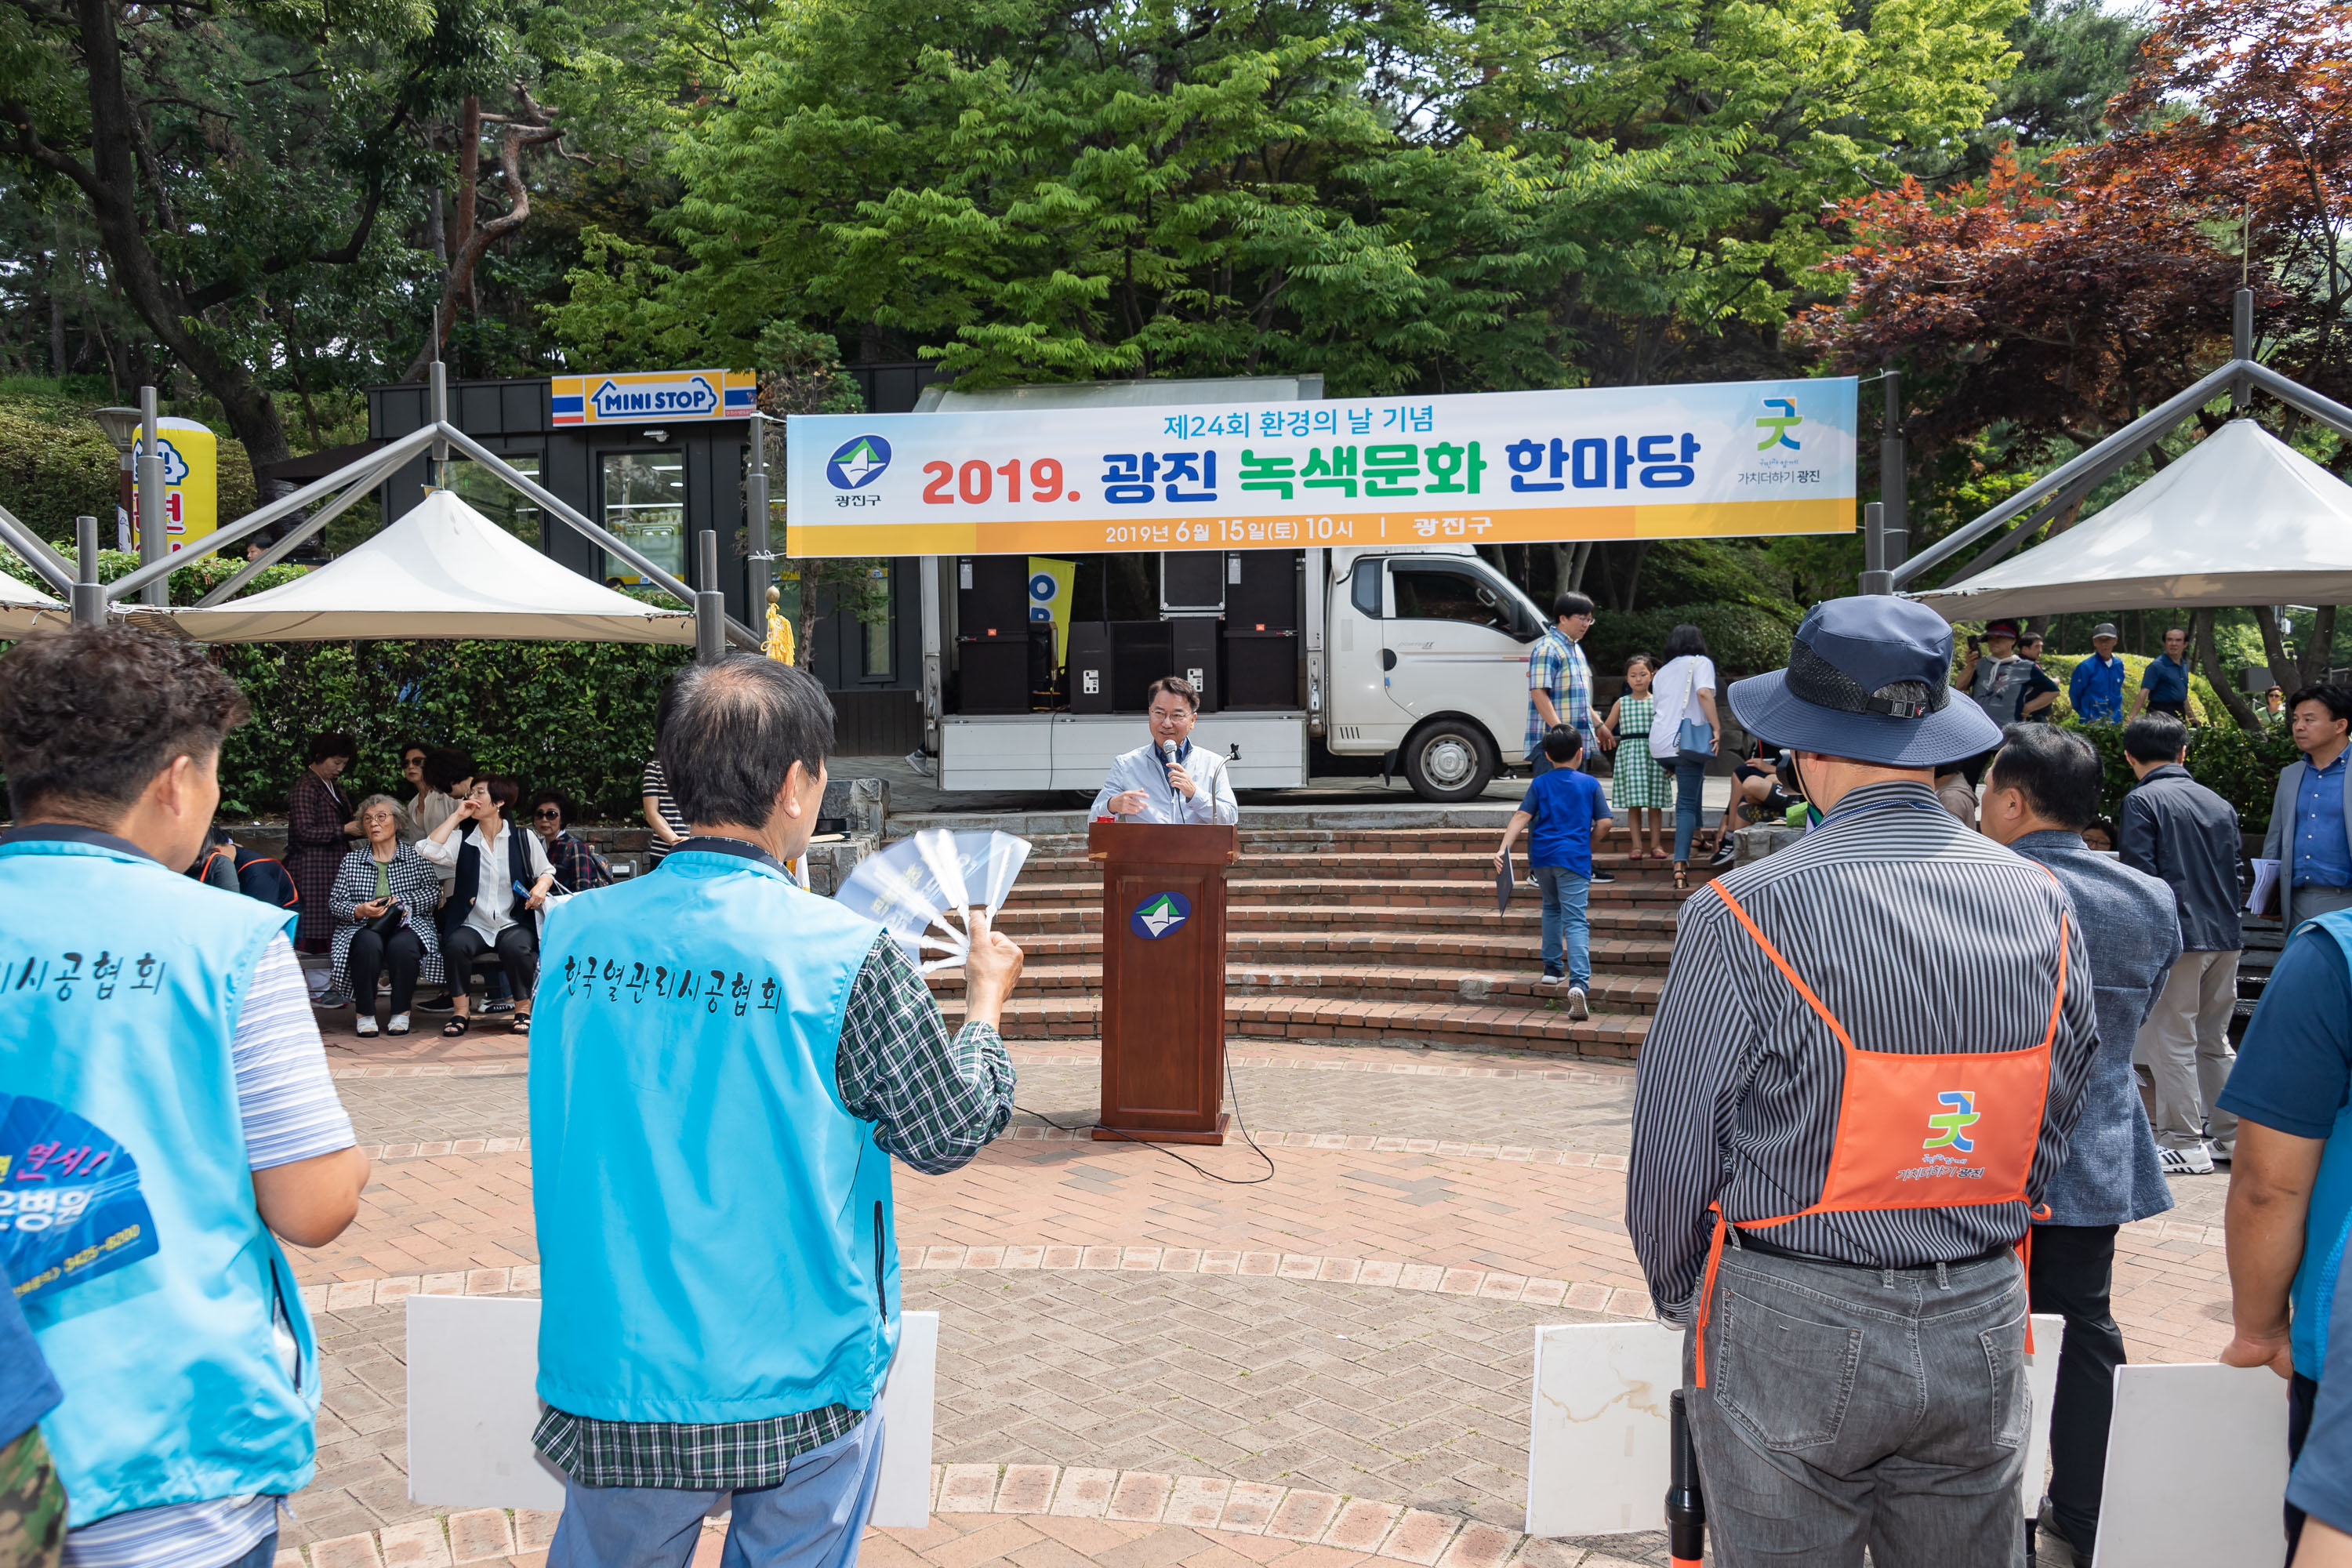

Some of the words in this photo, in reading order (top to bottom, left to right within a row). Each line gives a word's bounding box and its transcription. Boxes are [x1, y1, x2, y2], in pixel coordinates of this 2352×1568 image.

[605, 393, 651, 411] MINI
[655, 391, 706, 409] STOP
[1163, 411, 1250, 440] 제24회
[1259, 408, 1338, 437] 환경의
[1347, 406, 1373, 433] 날
[1383, 405, 1434, 433] 기념
[922, 459, 1080, 505] 2019.
[1102, 449, 1218, 504] 광진
[1238, 441, 1487, 500] 녹색문화
[1505, 432, 1700, 494] 한마당
[1738, 470, 1795, 485] 가치더하기
[1797, 470, 1820, 483] 광진
[834, 494, 881, 507] 광진구
[1105, 524, 1169, 543] 2019년
[1175, 520, 1210, 543] 6월
[1218, 517, 1298, 541] 15일(토)
[1305, 517, 1353, 539] 10시
[1413, 517, 1493, 537] 광진구
[1896, 1165, 1958, 1181] 가치더하기
[1957, 1167, 1985, 1178] 광진
